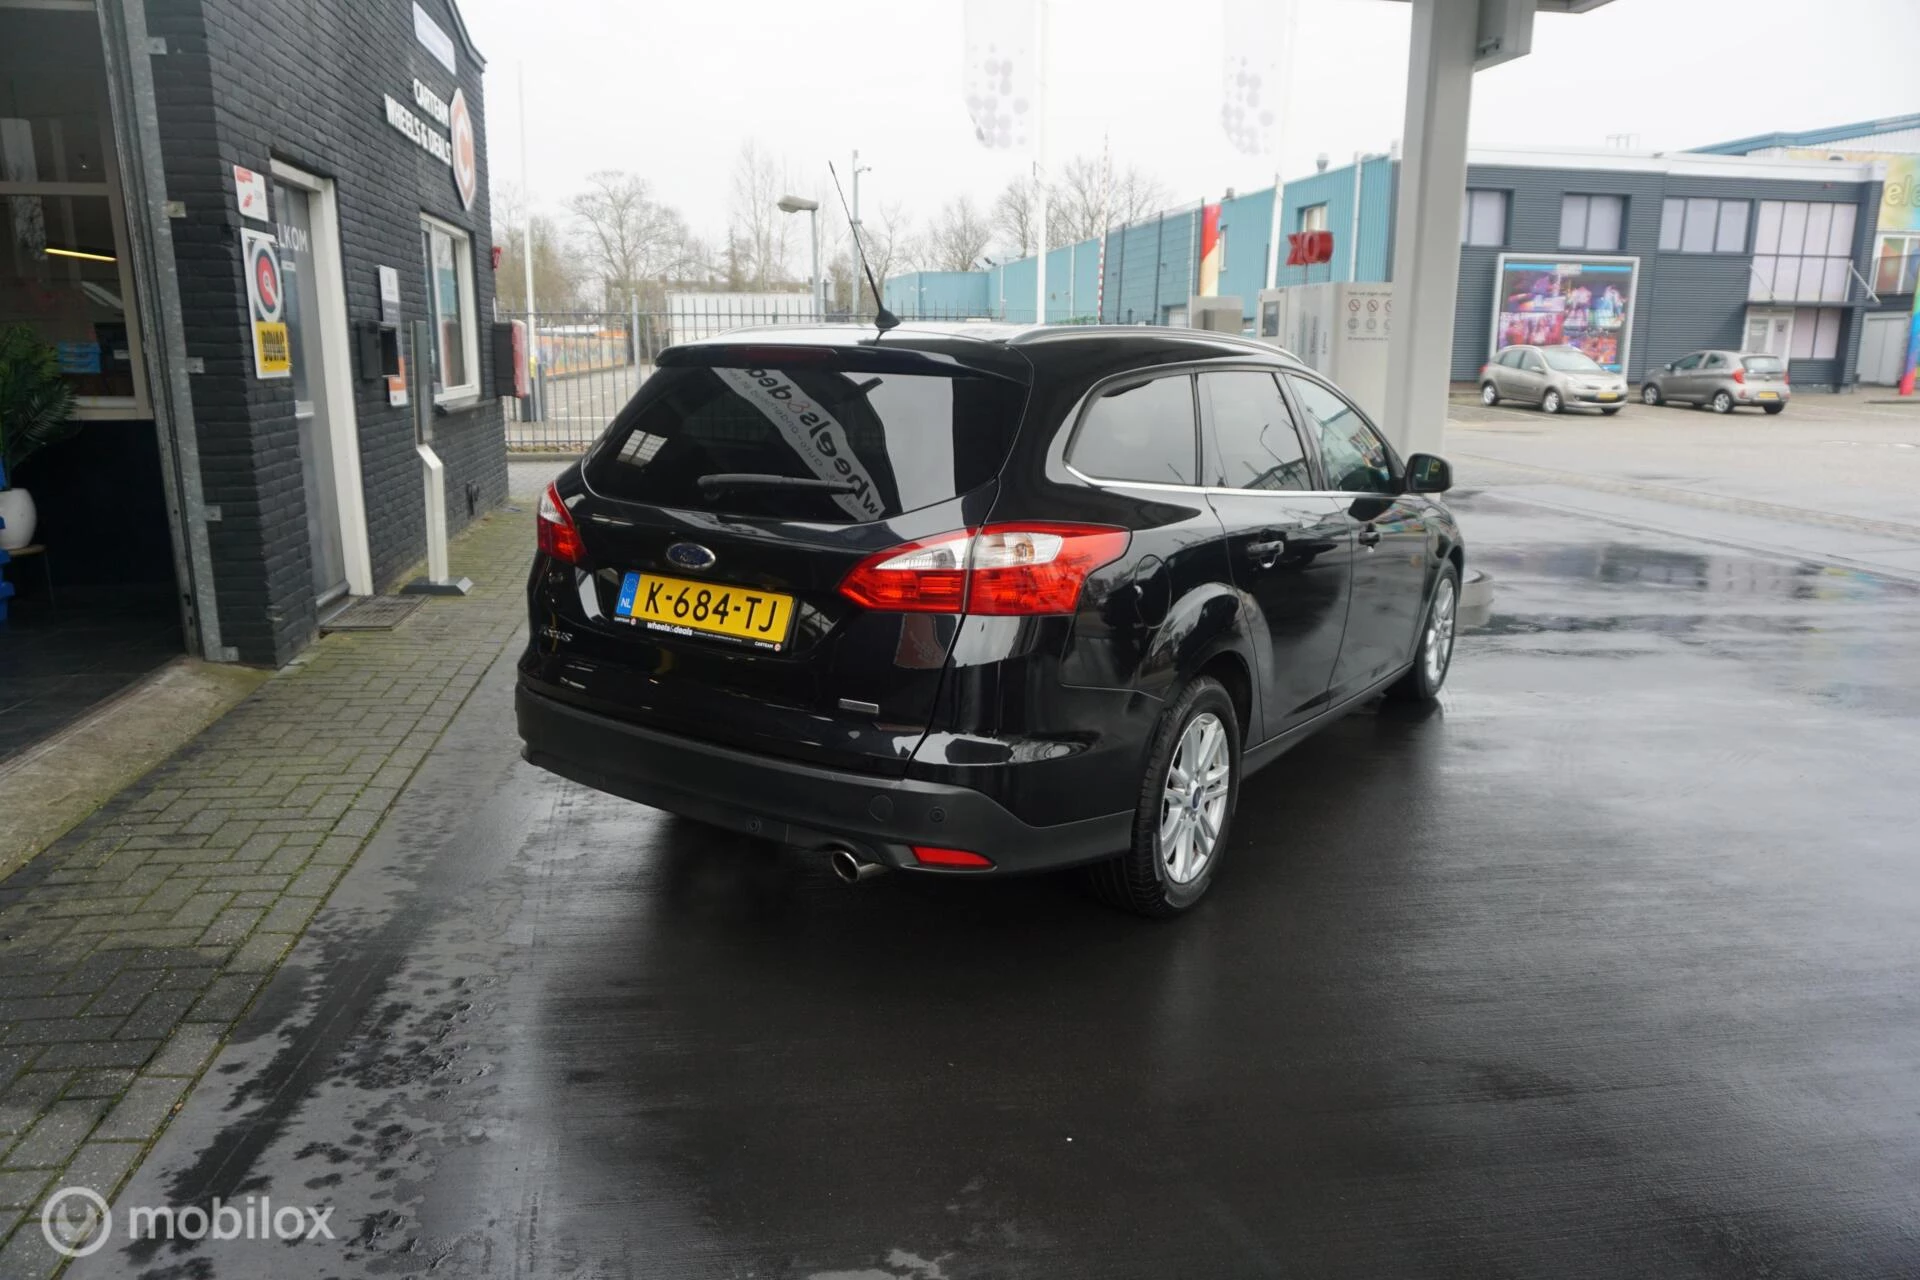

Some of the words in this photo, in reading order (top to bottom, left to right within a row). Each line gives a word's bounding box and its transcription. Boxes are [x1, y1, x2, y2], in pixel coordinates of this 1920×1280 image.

[413, 78, 449, 129] CARTEAM
[276, 222, 308, 252] LKOM
[620, 597, 631, 609] NL
[645, 581, 778, 633] K-684-TJ
